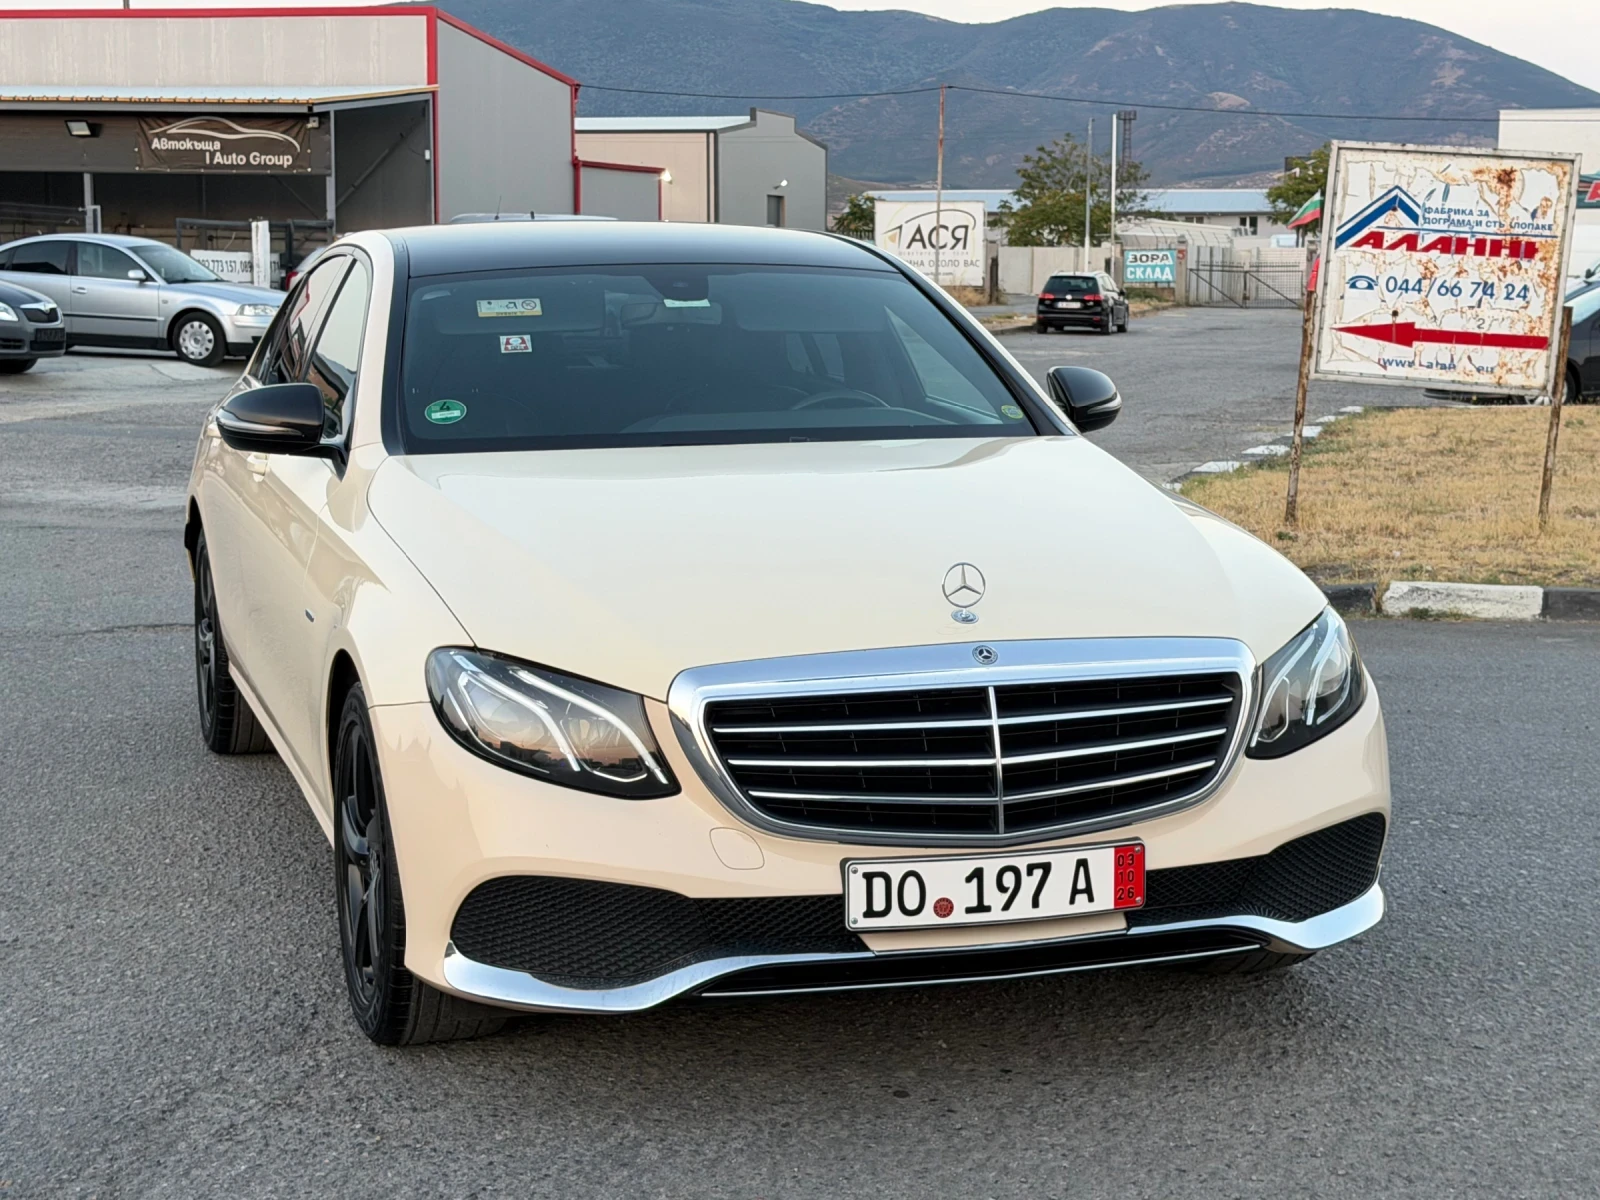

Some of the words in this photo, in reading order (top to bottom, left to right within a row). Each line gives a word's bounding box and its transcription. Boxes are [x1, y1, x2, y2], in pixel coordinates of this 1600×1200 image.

[151, 138, 221, 151] Автокъща
[213, 152, 246, 165] Auto
[249, 152, 293, 168] Group
[1424, 207, 1474, 217] ФАБРИКА
[1476, 210, 1490, 218] ЗА
[906, 223, 970, 250] АСЯ
[1128, 253, 1170, 264] ЗОРА
[1126, 266, 1173, 281] СКЛАД
[1469, 282, 1496, 298] 74
[1504, 284, 1530, 300] 24
[1117, 853, 1135, 867] 03
[1118, 870, 1135, 884] 10
[862, 869, 927, 919] DO
[964, 861, 1052, 915] 197
[1069, 857, 1095, 906] A
[1117, 886, 1135, 901] 26
